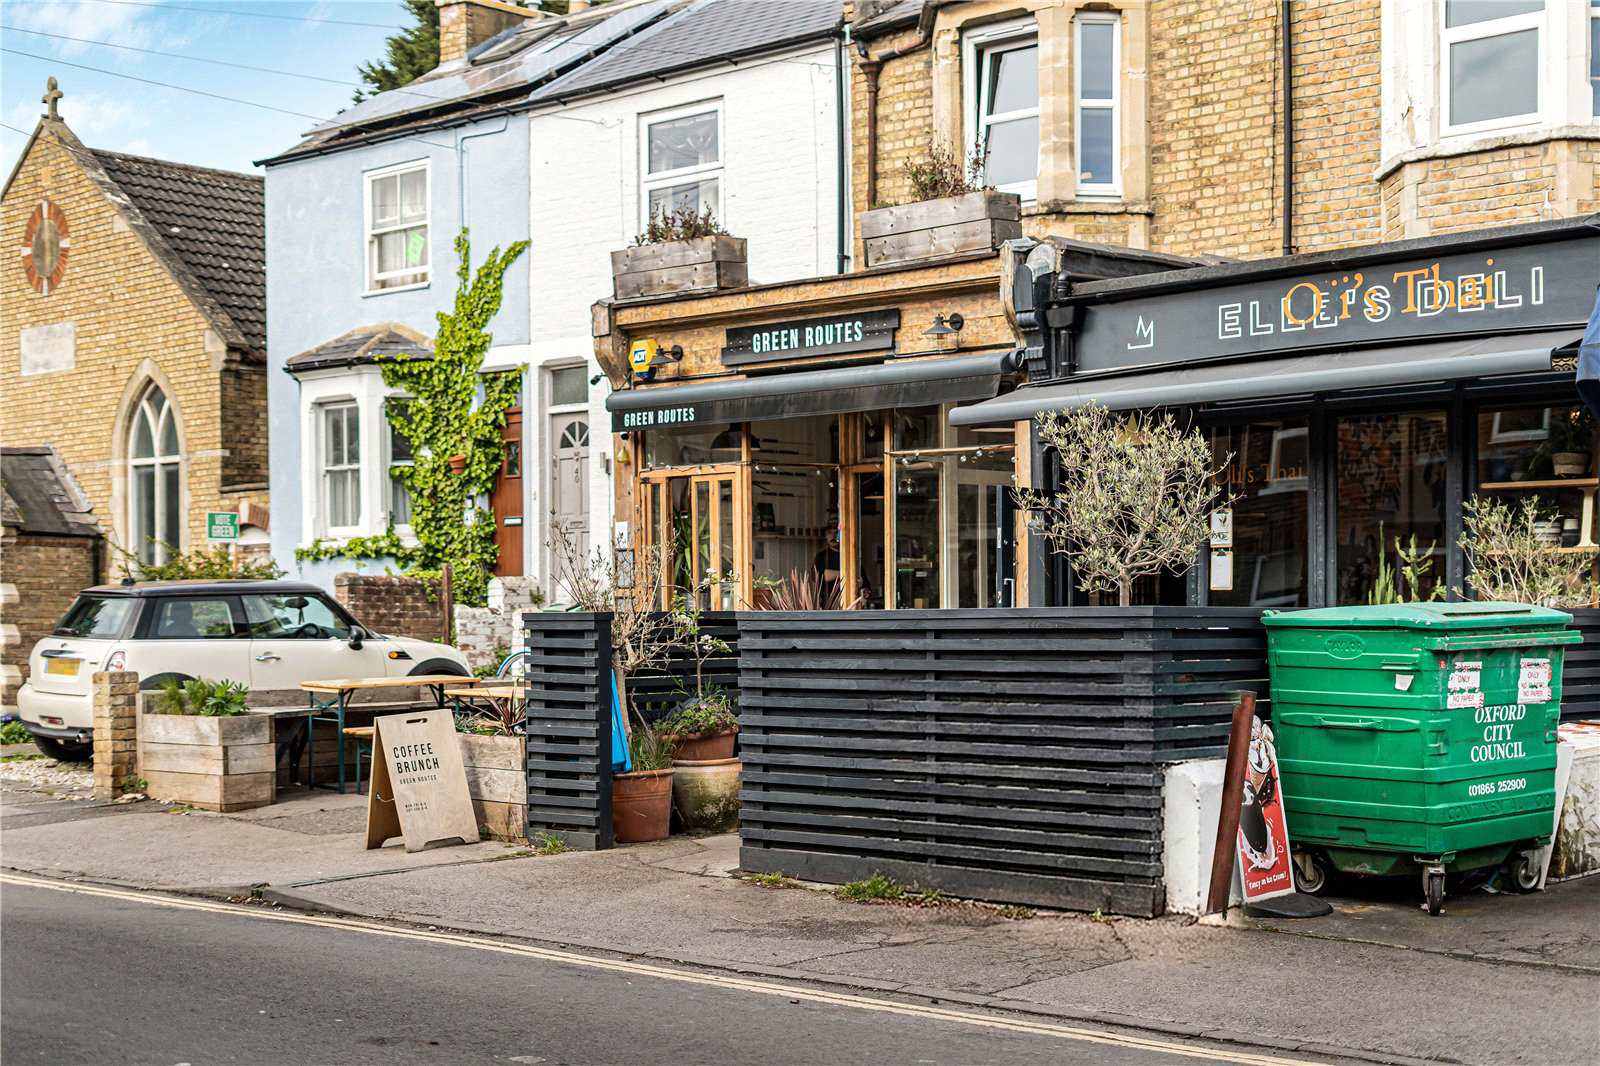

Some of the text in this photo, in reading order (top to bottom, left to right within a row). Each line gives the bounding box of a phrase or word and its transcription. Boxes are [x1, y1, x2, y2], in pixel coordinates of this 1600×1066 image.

[1392, 258, 1496, 314] Thai
[1417, 266, 1544, 317] DELI
[752, 320, 863, 353] GREEN ROUTES
[634, 350, 646, 362] ADT
[624, 407, 695, 427] GREEN ROUTES
[1261, 463, 1304, 482] Thai
[1475, 704, 1526, 723] OXFORD
[1484, 724, 1514, 742] CITY
[393, 743, 433, 759] COFFEE
[1471, 742, 1526, 762] COUNCIL
[396, 757, 440, 773] BRUNCH
[1497, 778, 1526, 792] 252900
